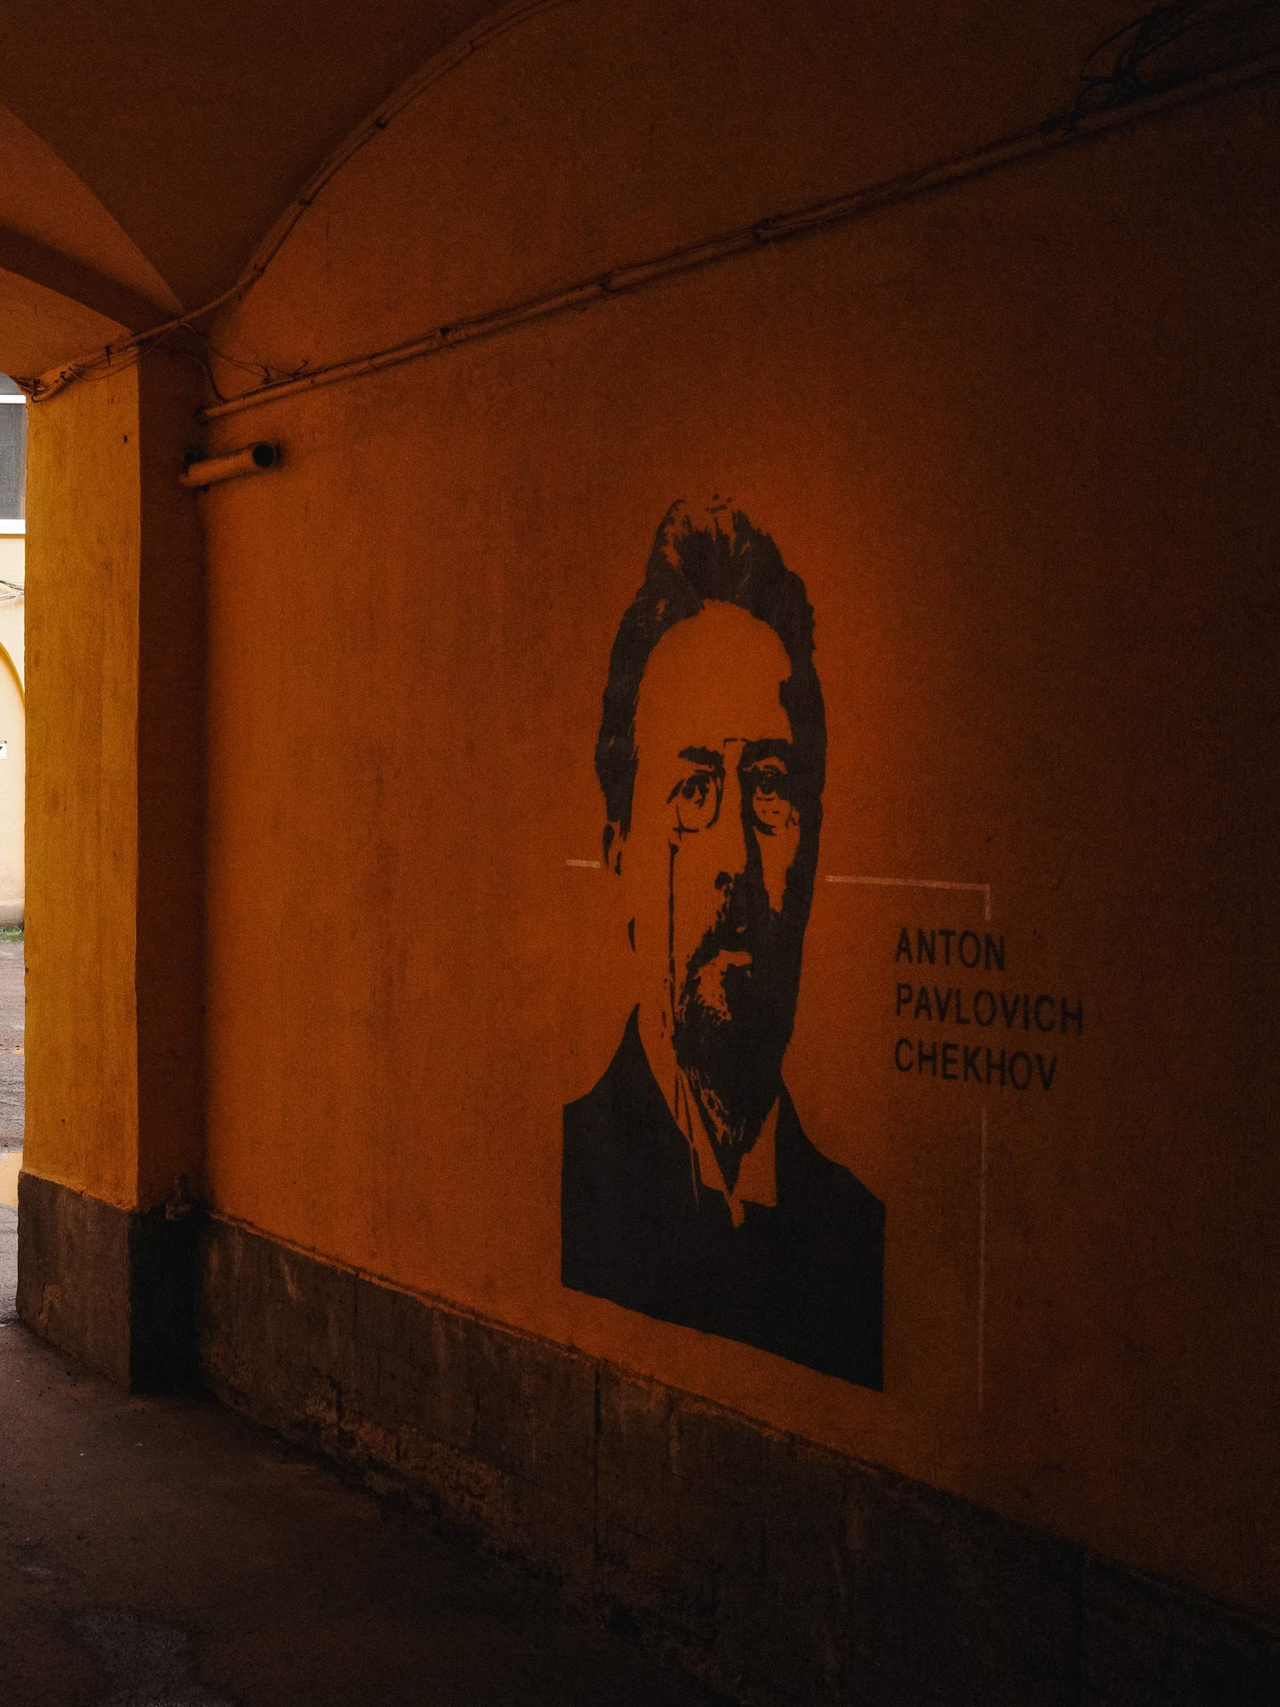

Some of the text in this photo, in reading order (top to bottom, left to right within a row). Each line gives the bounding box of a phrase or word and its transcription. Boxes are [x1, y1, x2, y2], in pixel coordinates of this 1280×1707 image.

[895, 927, 1005, 971] ANTON
[895, 983, 1084, 1036] PAVLOVICH
[895, 1037, 1057, 1092] CHEKHOV
